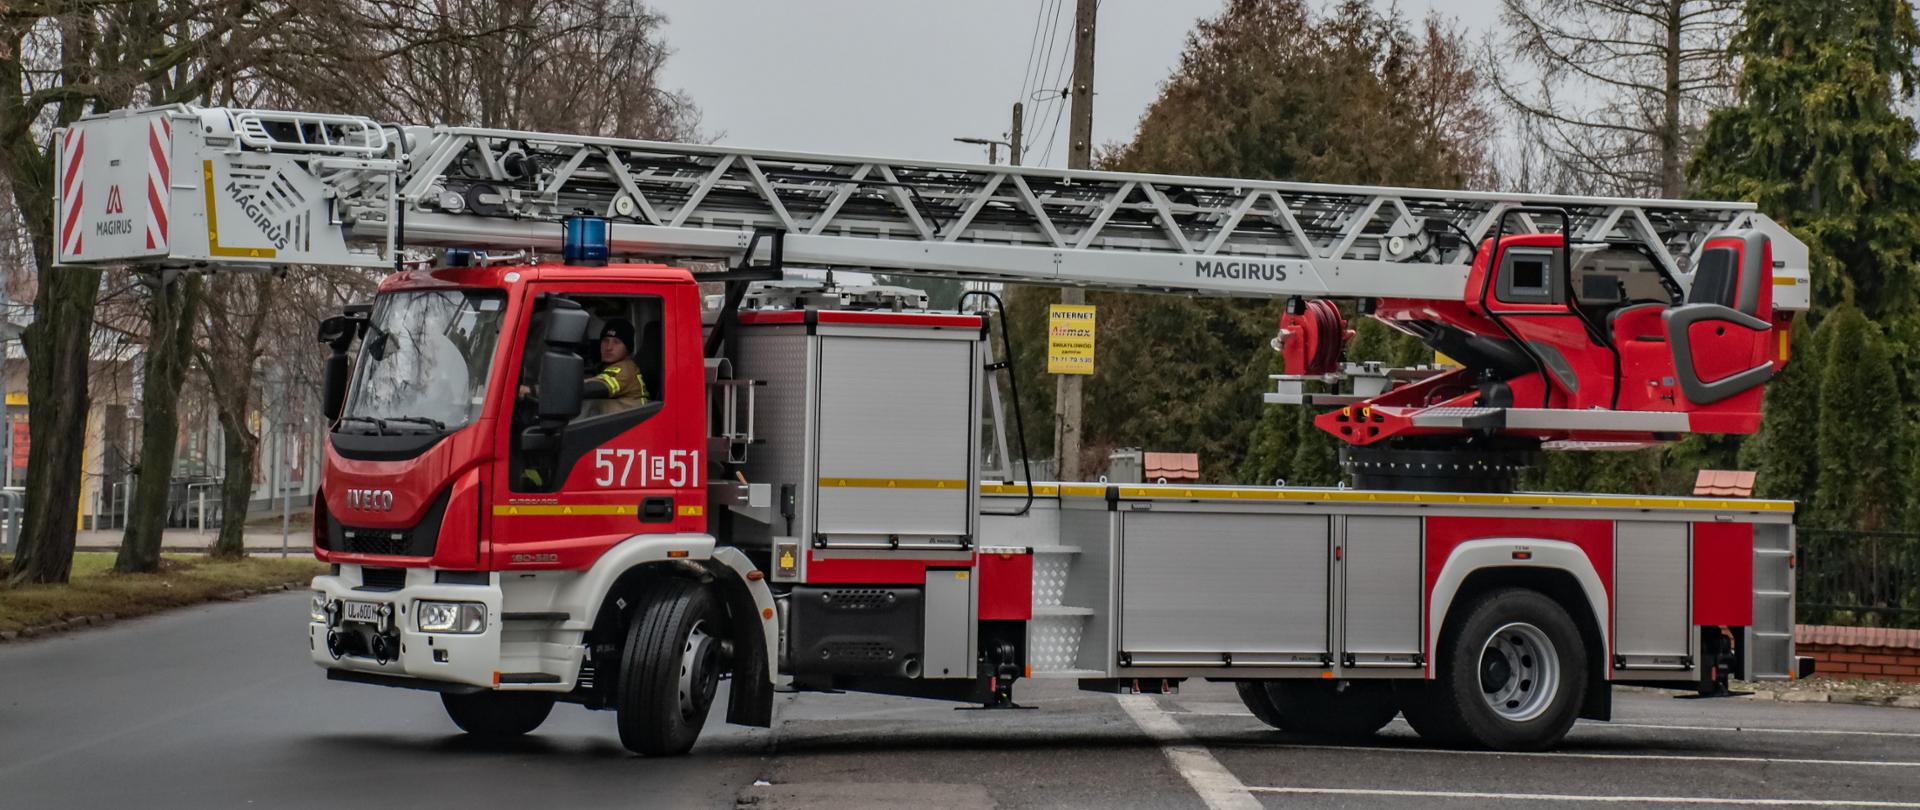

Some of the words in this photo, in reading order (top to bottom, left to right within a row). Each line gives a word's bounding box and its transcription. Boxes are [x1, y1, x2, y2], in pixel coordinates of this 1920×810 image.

[96, 219, 132, 236] MAGIRUS
[225, 181, 288, 250] MAGIRUS
[1195, 261, 1287, 281] MAGIRUS
[595, 448, 647, 487] 571
[669, 449, 699, 488] 51
[347, 488, 393, 512] IVECO
